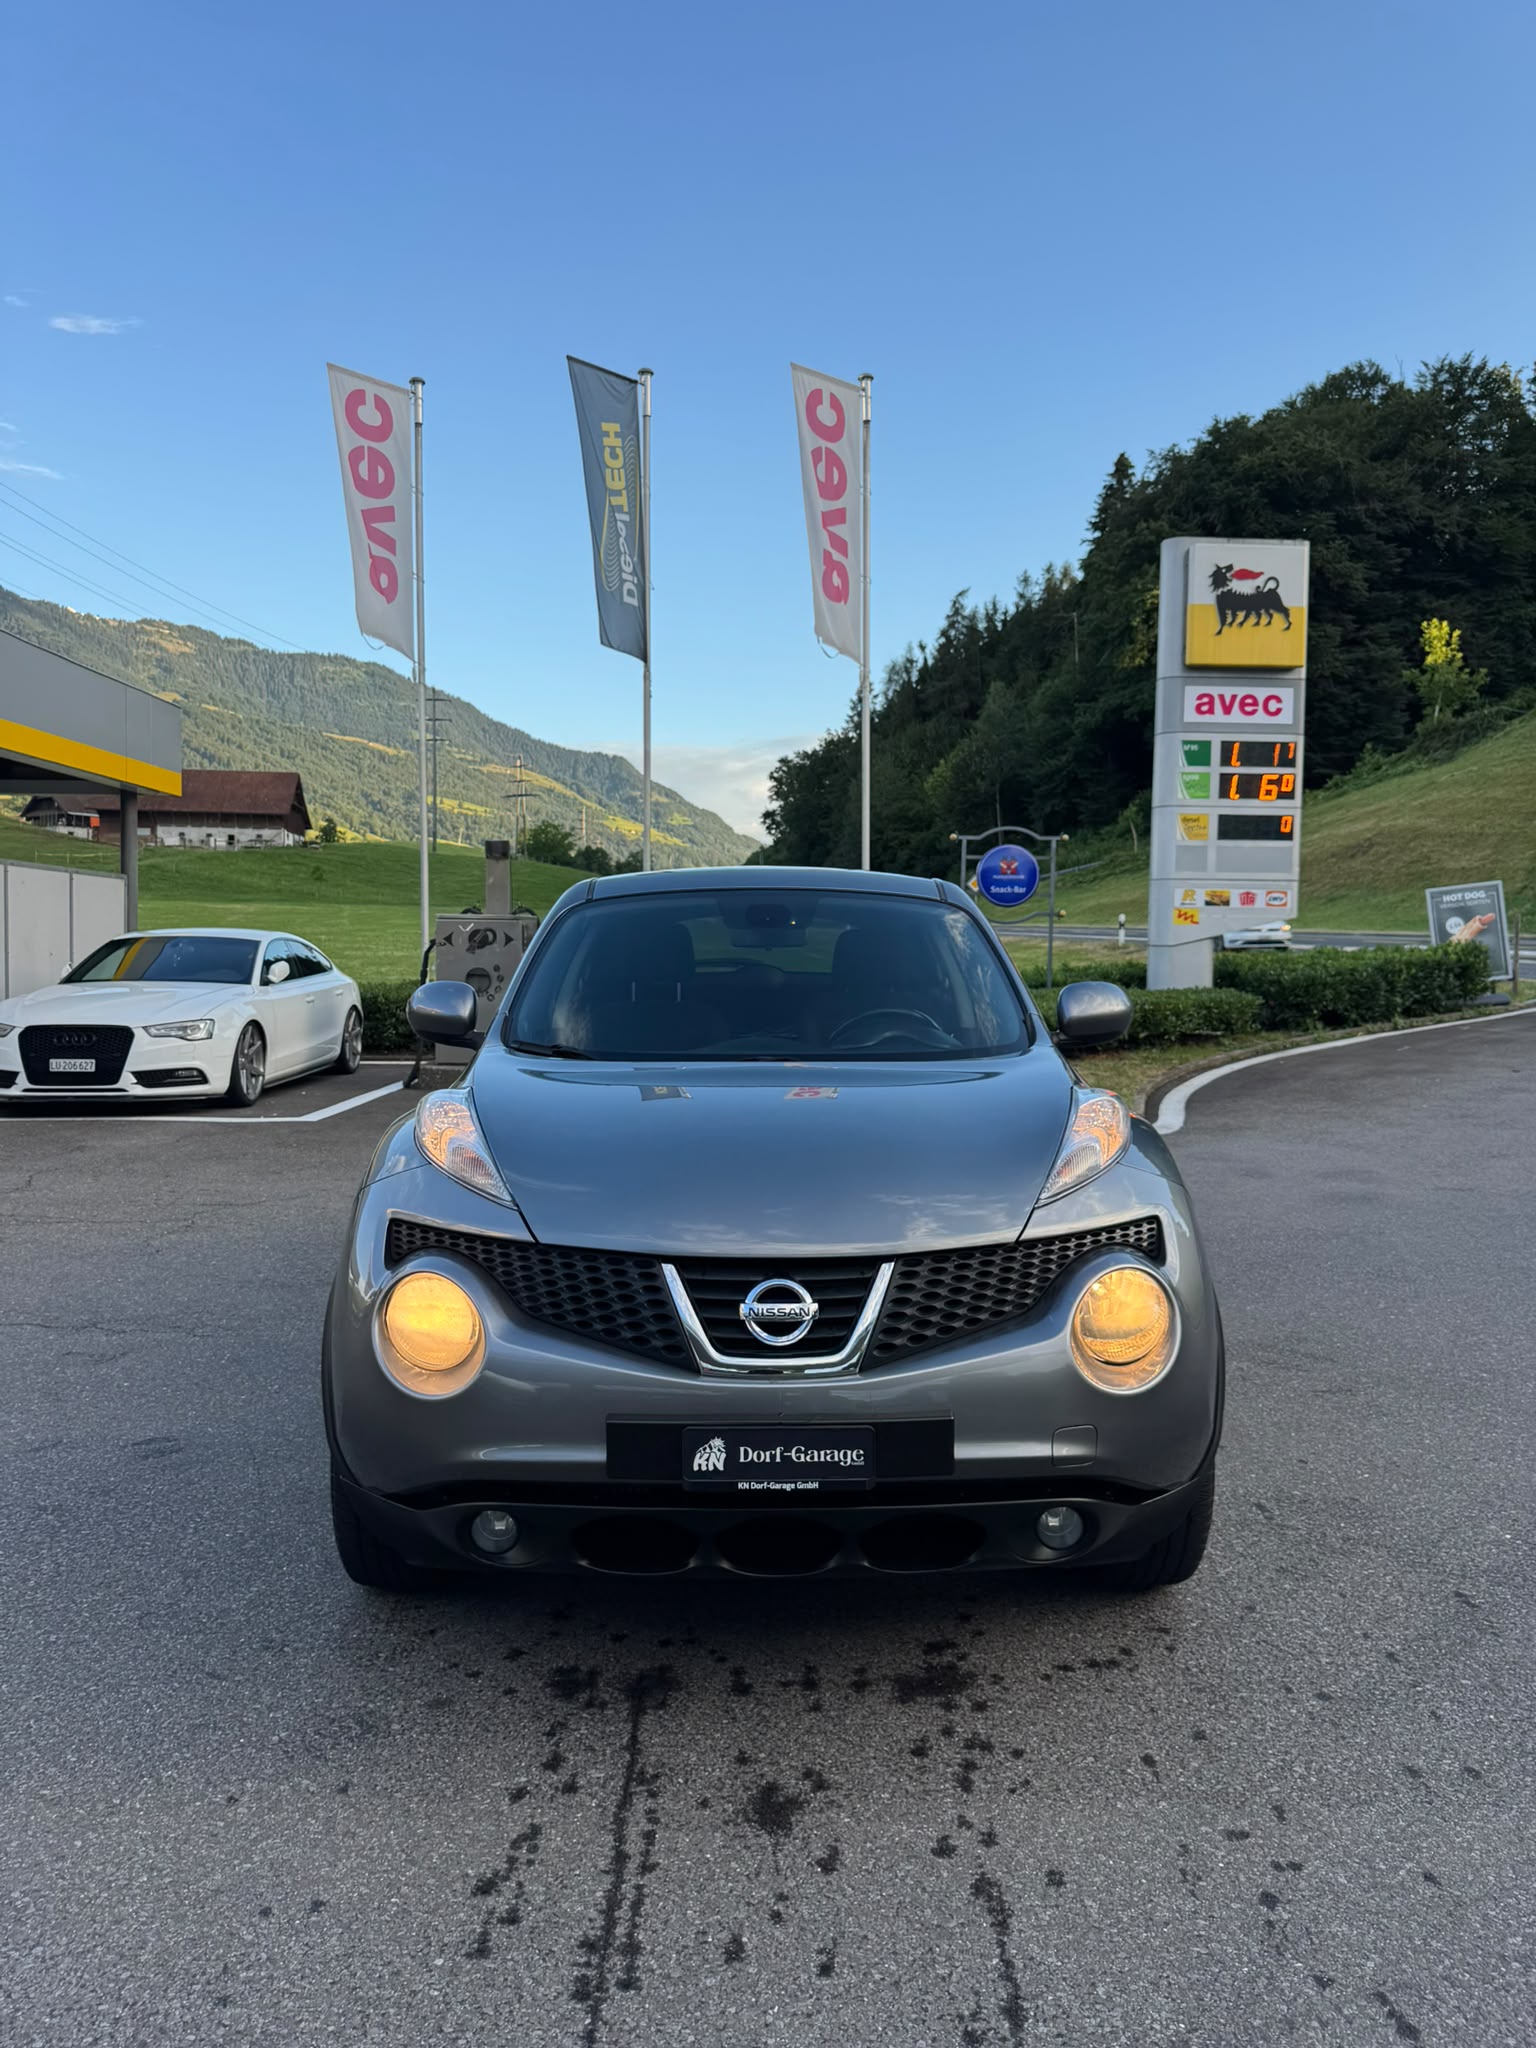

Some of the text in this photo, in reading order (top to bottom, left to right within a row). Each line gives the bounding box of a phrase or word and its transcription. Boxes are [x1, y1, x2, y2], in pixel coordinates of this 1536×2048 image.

[1194, 692, 1283, 717] avec
[990, 885, 1027, 893] Snack-Bar
[1442, 890, 1486, 903] HOT DOG
[747, 1307, 811, 1318] NISSAN
[693, 1445, 865, 1472] KN Dorf-Garage
[737, 1481, 819, 1491] KN Dorf-Garage GmbH
